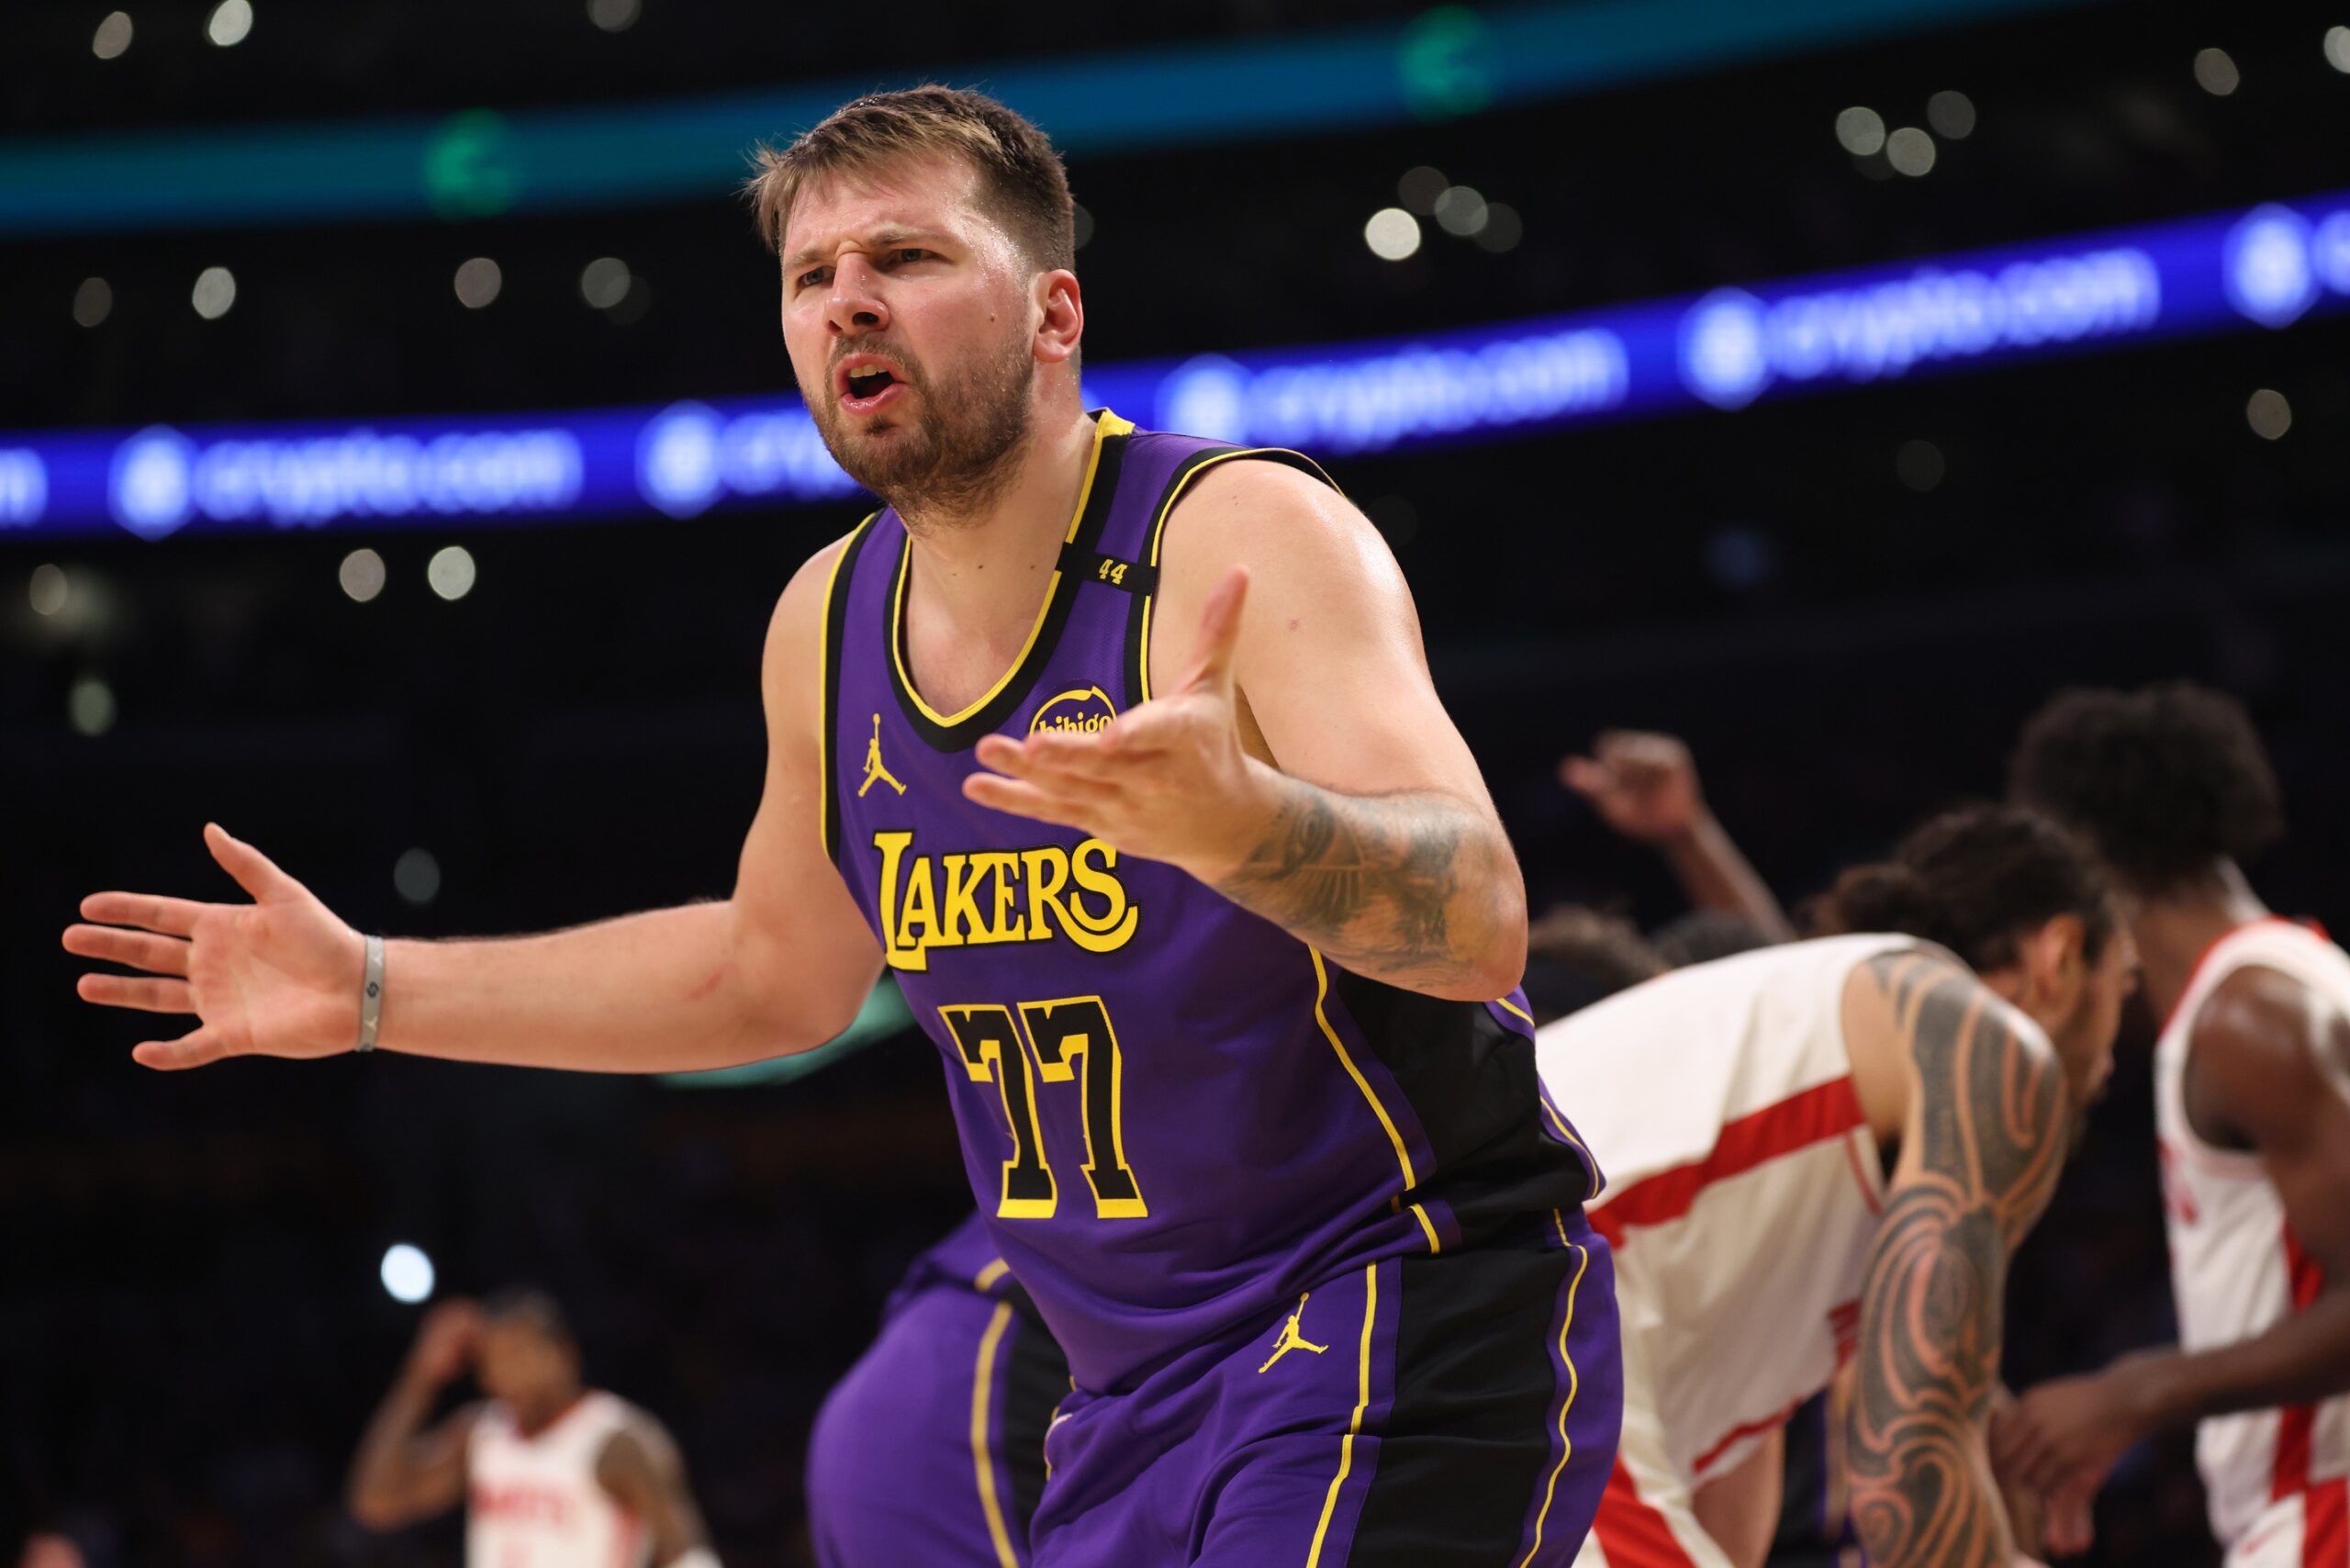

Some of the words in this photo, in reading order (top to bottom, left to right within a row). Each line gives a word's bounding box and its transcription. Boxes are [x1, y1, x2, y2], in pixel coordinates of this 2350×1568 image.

[1099, 559, 1128, 585] 44
[873, 830, 1139, 973] LAKERS
[936, 995, 1148, 1218] 77
